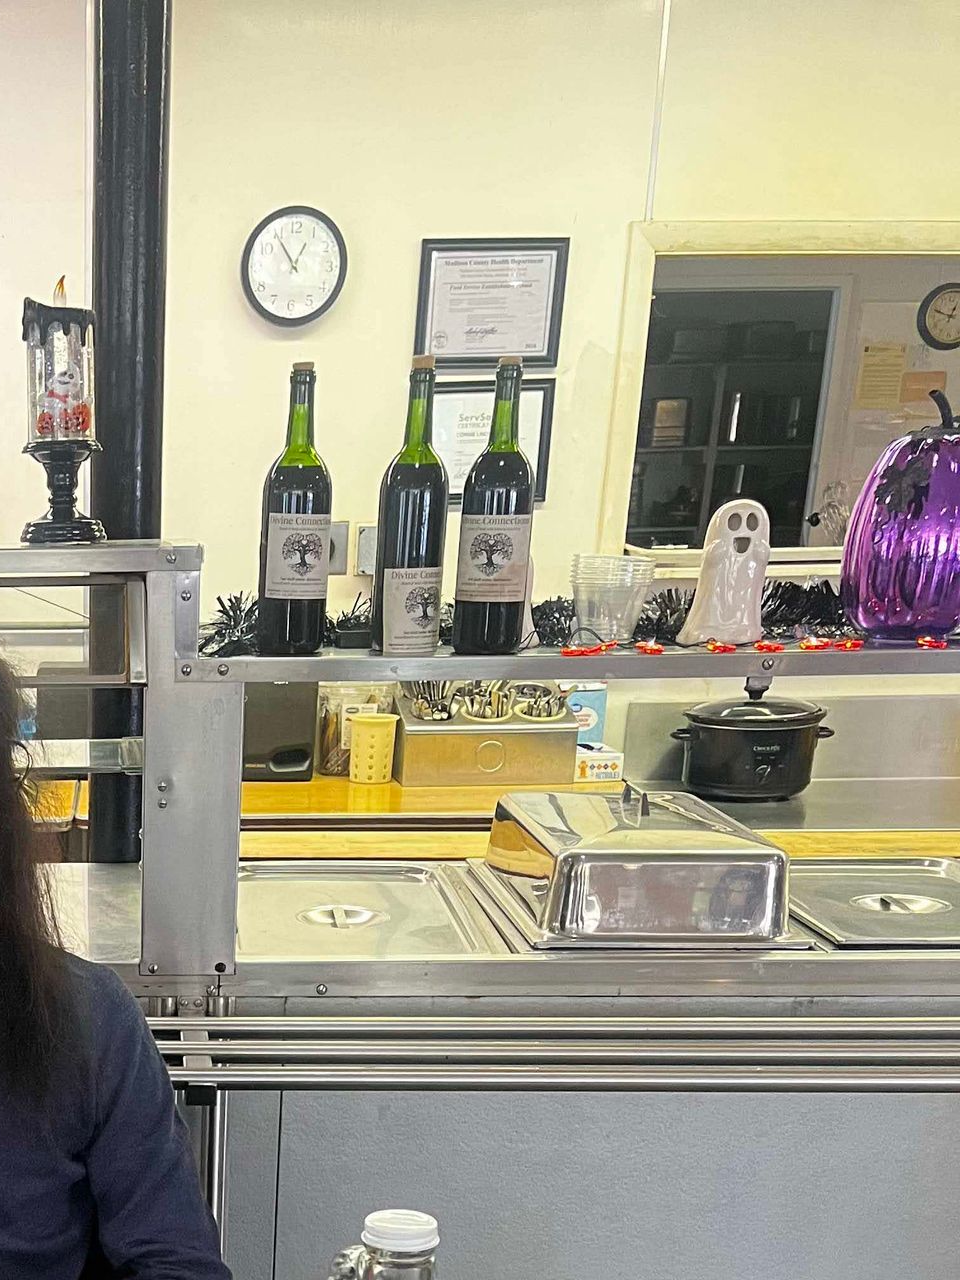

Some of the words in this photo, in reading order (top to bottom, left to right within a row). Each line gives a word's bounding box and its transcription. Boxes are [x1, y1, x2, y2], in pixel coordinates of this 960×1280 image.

[291, 222, 303, 234] 12
[261, 242, 274, 256] 10
[326, 261, 334, 273] 3
[257, 281, 266, 293] 8
[271, 295, 278, 305] 7
[287, 300, 296, 311] 6
[305, 295, 313, 306] 5
[459, 413, 491, 422] ServSa
[271, 516, 293, 525] Divine
[392, 571, 418, 580] Divine
